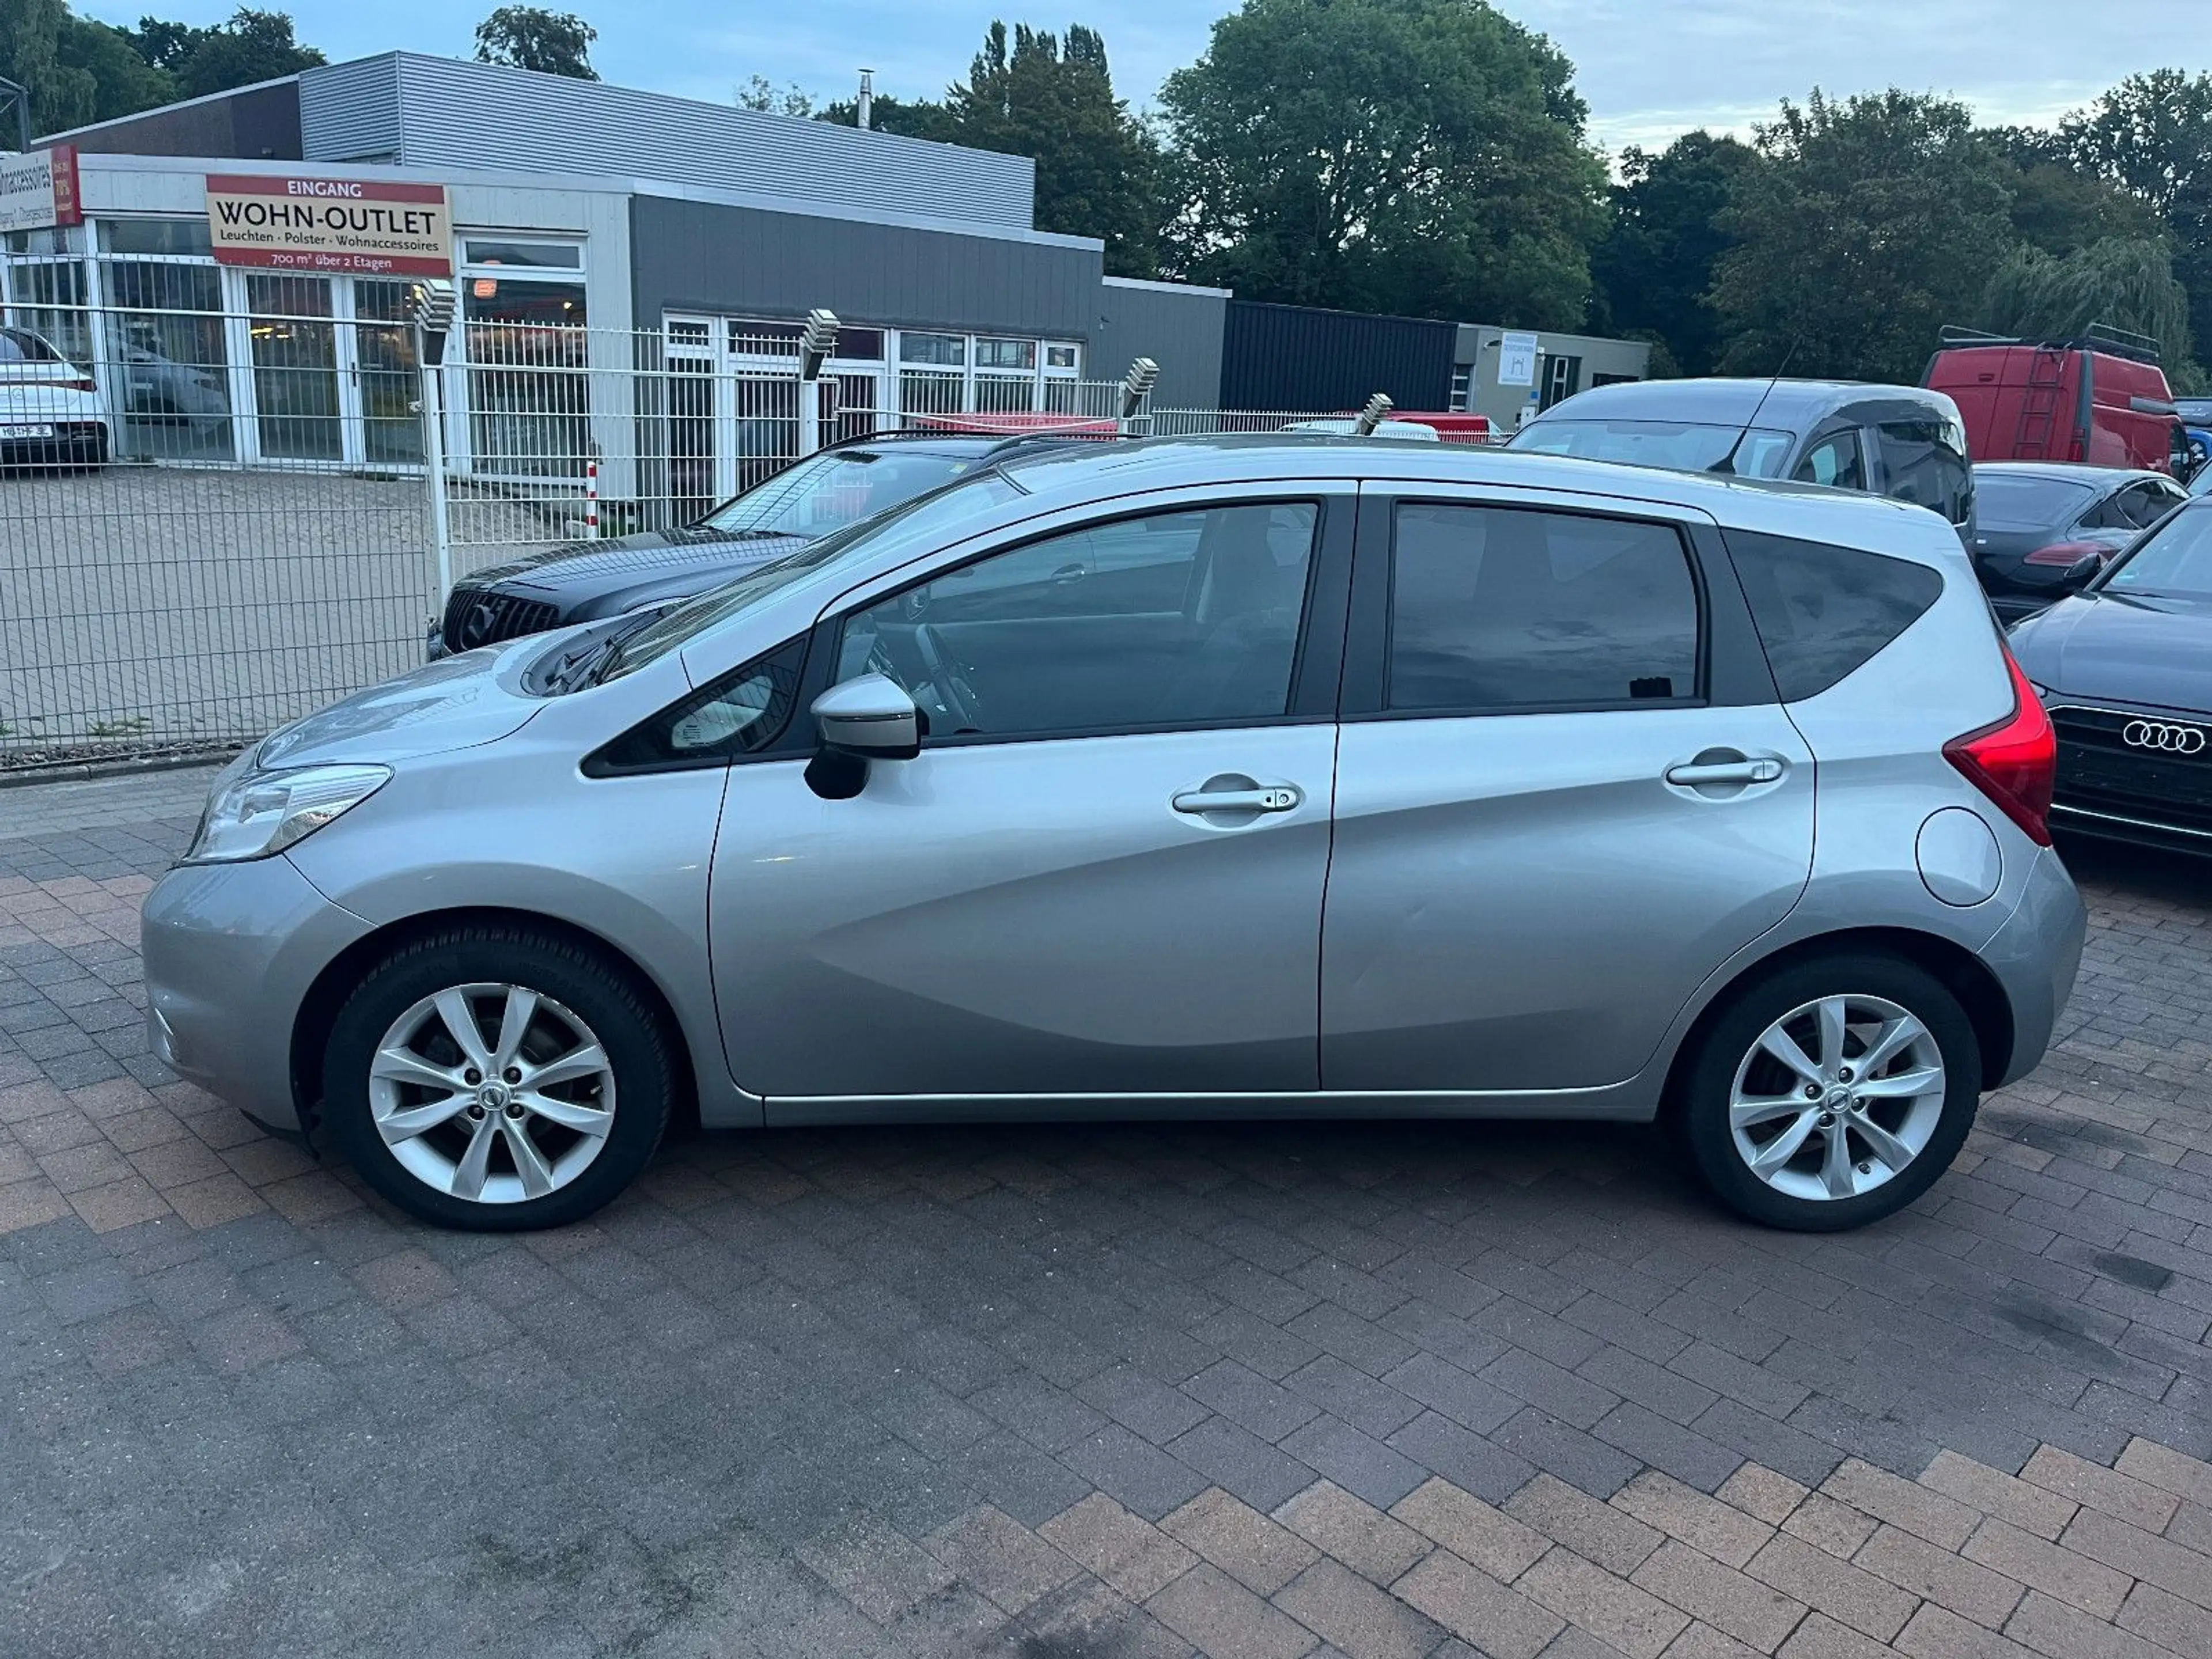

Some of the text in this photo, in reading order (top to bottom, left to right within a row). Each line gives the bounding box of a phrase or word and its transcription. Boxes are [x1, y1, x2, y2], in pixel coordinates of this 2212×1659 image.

[287, 180, 363, 198] EINGANG
[217, 201, 436, 235] WOHN-OUTLET
[221, 229, 439, 251] Leuchten Polster Wohnaccessoires
[271, 254, 294, 265] 700
[315, 254, 340, 266] über
[344, 258, 351, 266] 2
[354, 255, 392, 271] Etagen
